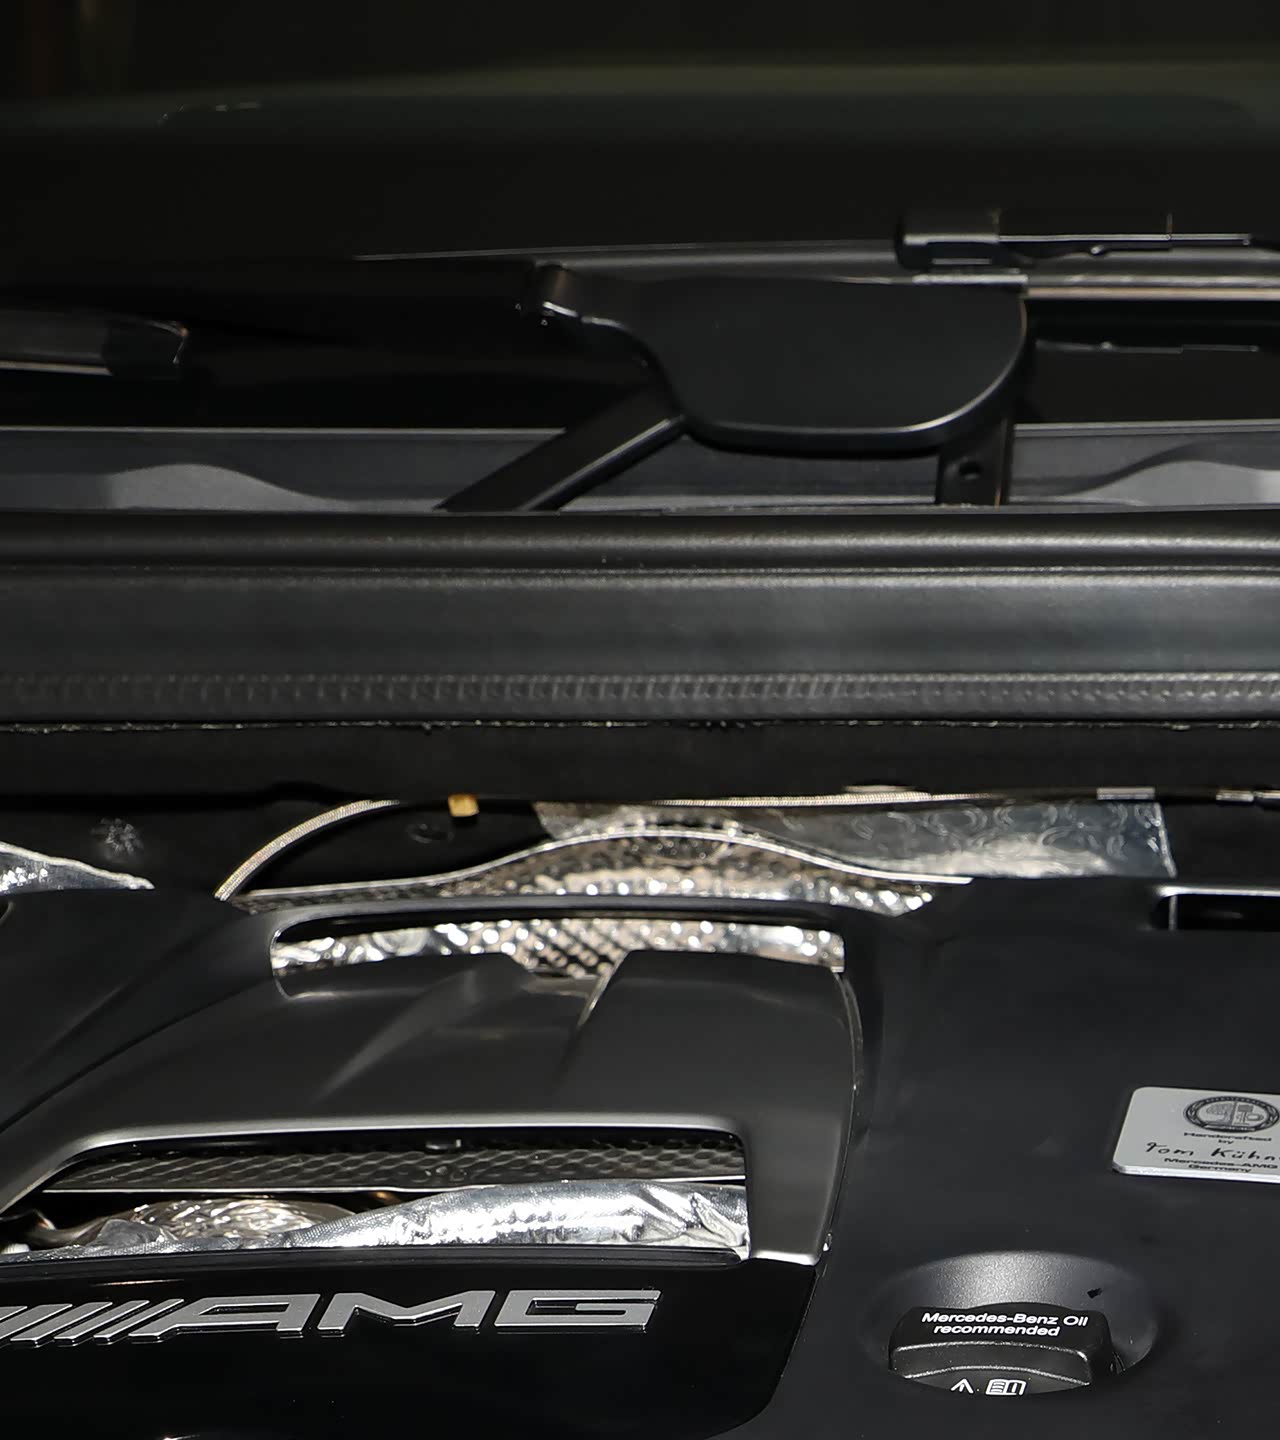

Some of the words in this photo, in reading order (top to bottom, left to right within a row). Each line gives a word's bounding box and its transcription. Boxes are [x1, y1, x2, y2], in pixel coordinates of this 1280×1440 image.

[1145, 1141, 1194, 1156] Tom
[1163, 1157, 1279, 1169] Mercedes-AMG
[1188, 1164, 1253, 1174] Germany
[128, 1290, 662, 1343] AMG
[921, 1312, 1060, 1326] Mercedes-Benz
[1062, 1315, 1089, 1327] Oil
[933, 1324, 1061, 1337] recommended
